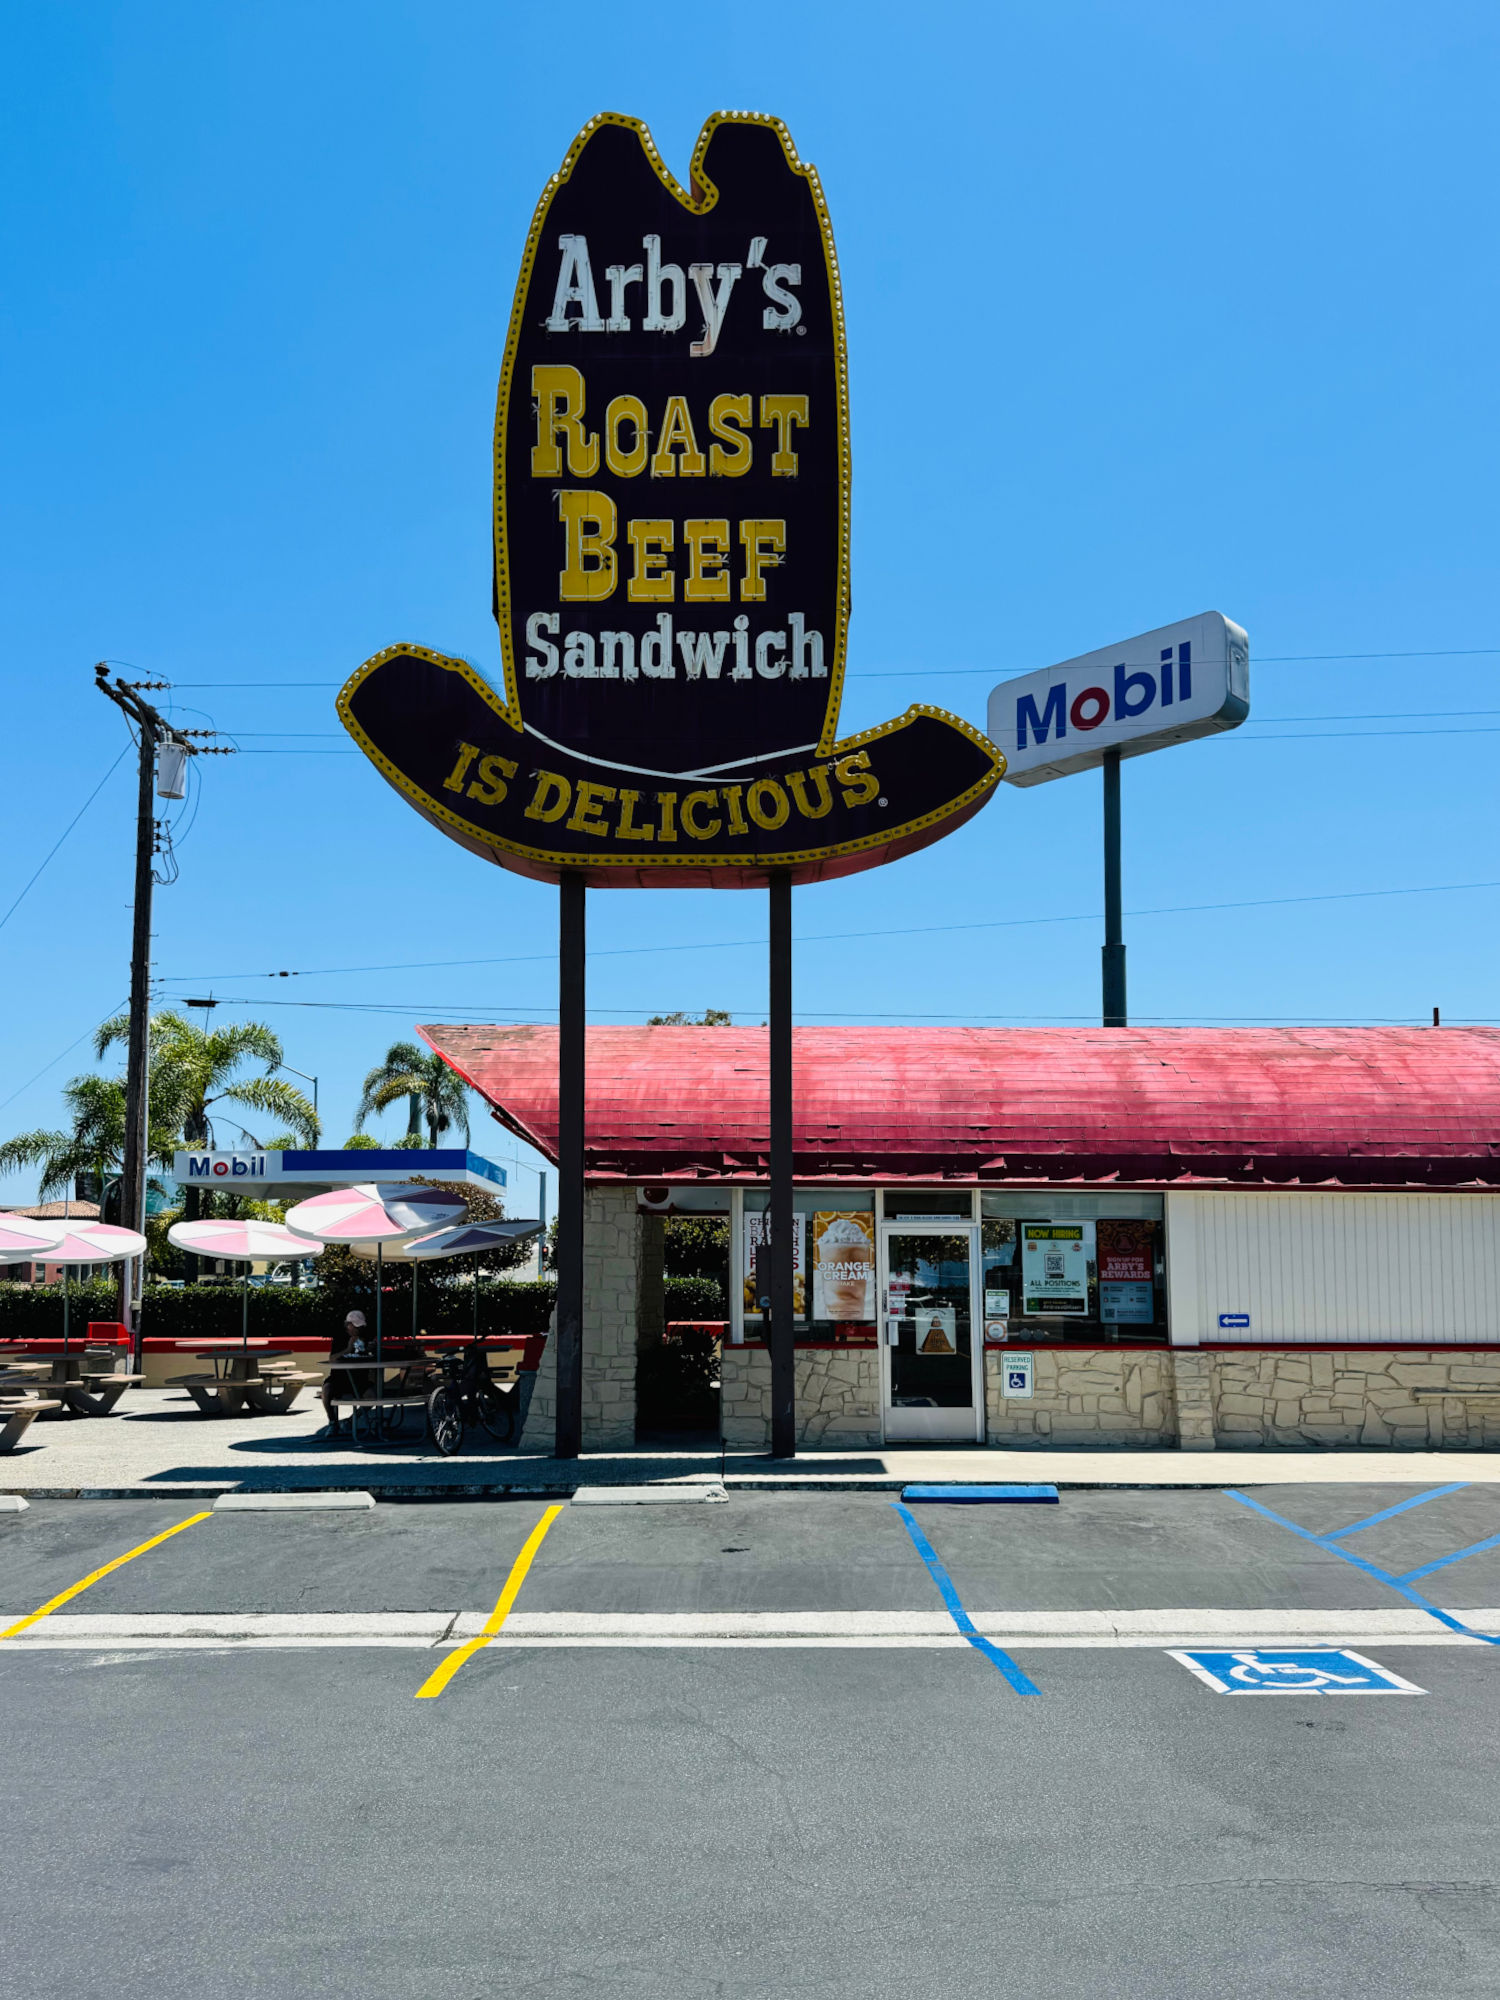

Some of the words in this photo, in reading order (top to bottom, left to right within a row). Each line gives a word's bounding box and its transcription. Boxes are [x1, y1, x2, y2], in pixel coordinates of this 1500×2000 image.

[545, 234, 803, 357] Arby's
[531, 364, 810, 478] ROAST
[558, 489, 786, 602] BEEF
[525, 612, 828, 679] Sandwich
[1016, 640, 1192, 752] Mobil
[443, 742, 518, 805] IS
[524, 751, 881, 842] DELICIOUS
[188, 1155, 268, 1177] Mobil
[1027, 1229, 1049, 1239] NOW
[1052, 1229, 1081, 1239] HIRING
[817, 1261, 870, 1271] ORANGE
[823, 1271, 868, 1281] CREAM
[1030, 1279, 1043, 1287] ALL
[1044, 1279, 1081, 1287] POSITIONS
[1100, 1270, 1151, 1279] REWARDS
